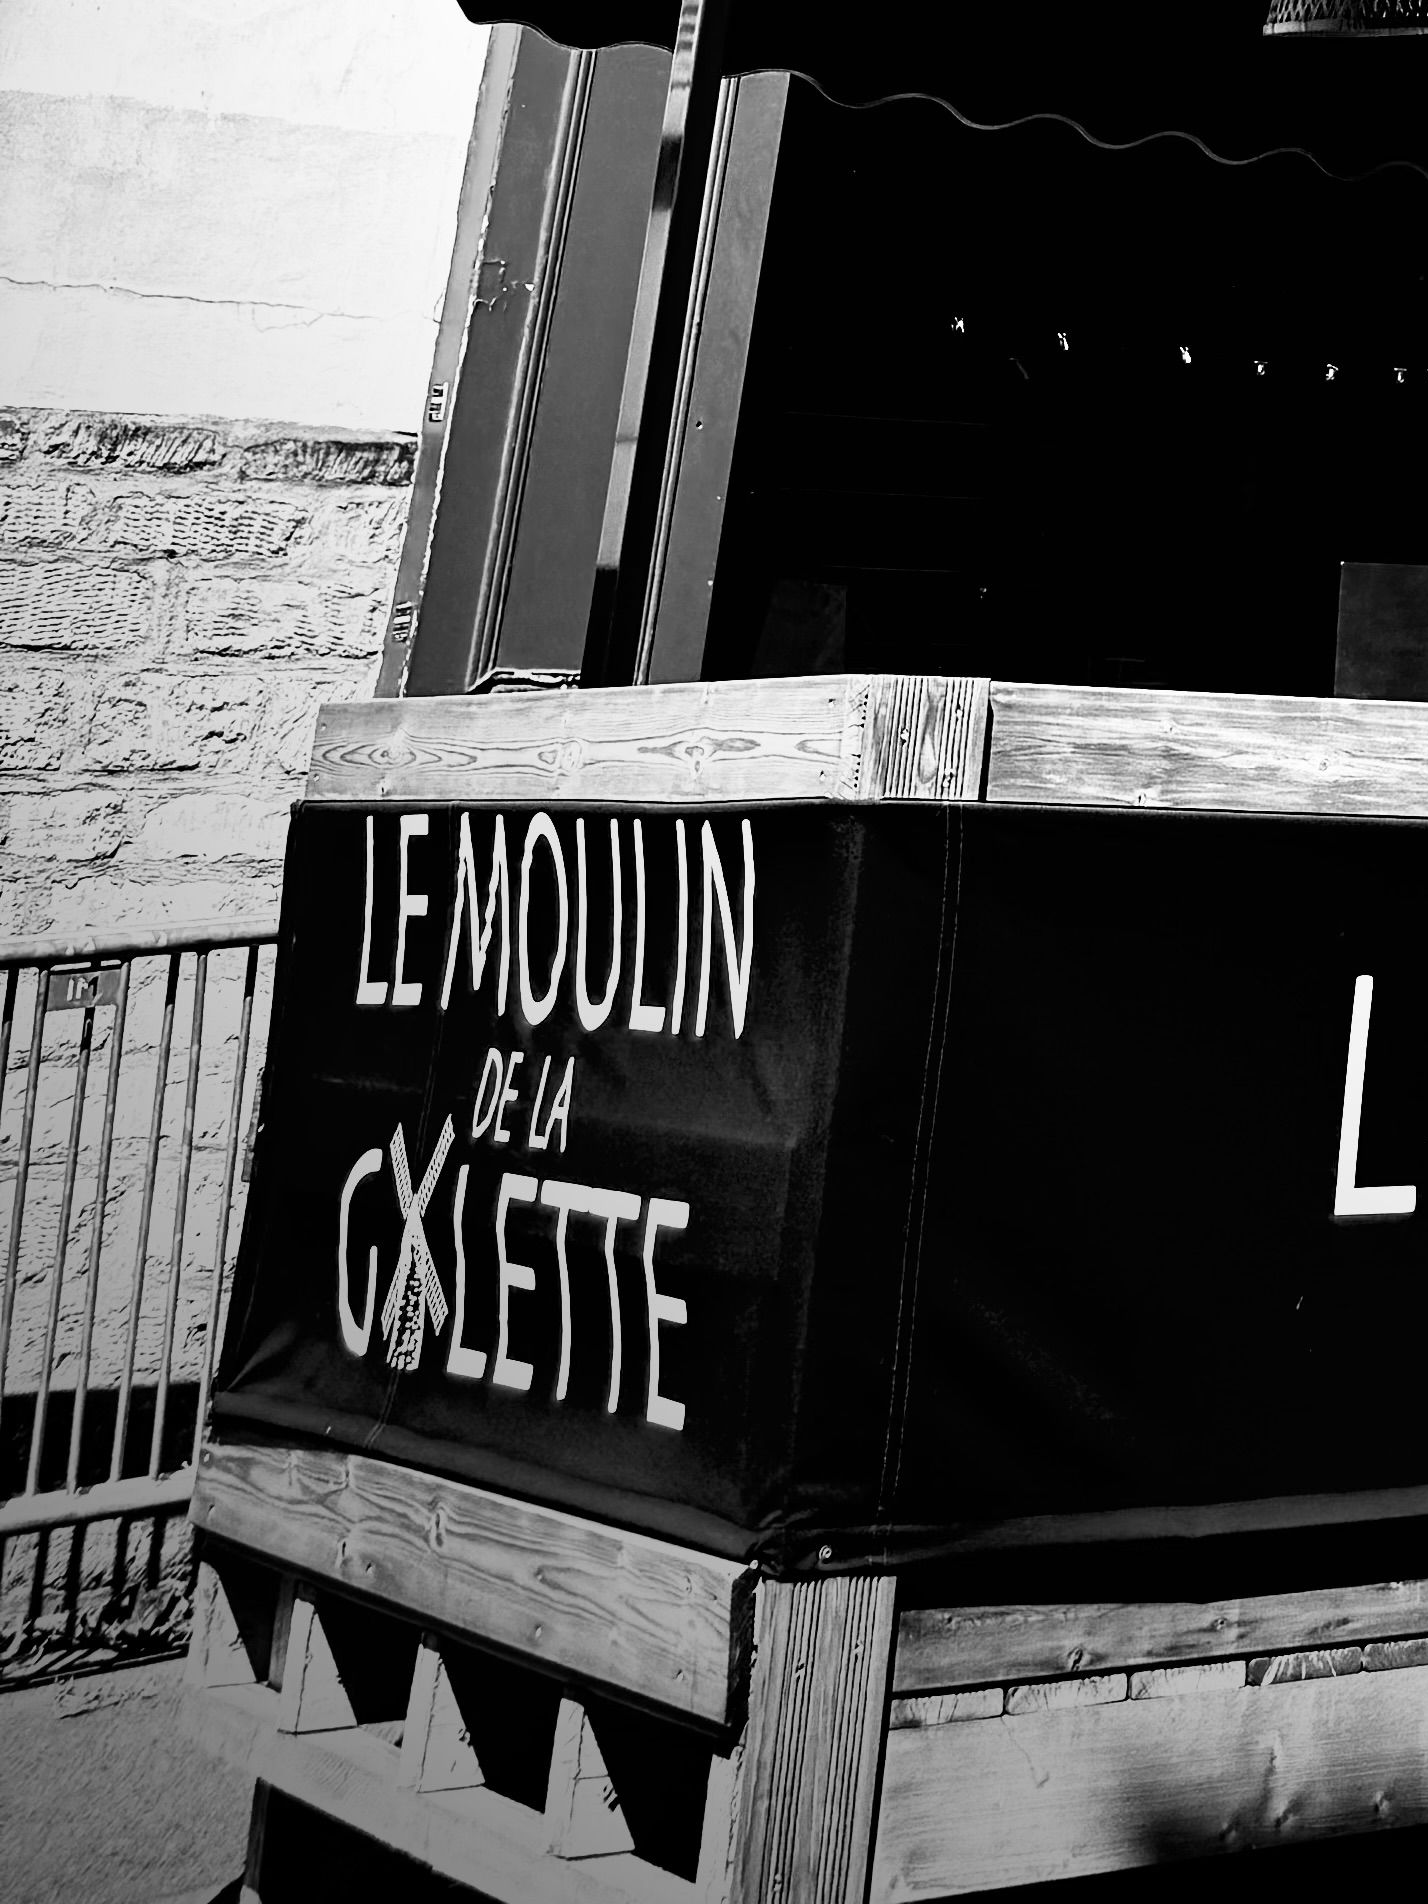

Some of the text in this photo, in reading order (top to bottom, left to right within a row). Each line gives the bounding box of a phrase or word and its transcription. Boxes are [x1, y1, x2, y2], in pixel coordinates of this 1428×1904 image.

[355, 811, 756, 1040] LE MOULIN
[471, 1047, 576, 1154] DE LA
